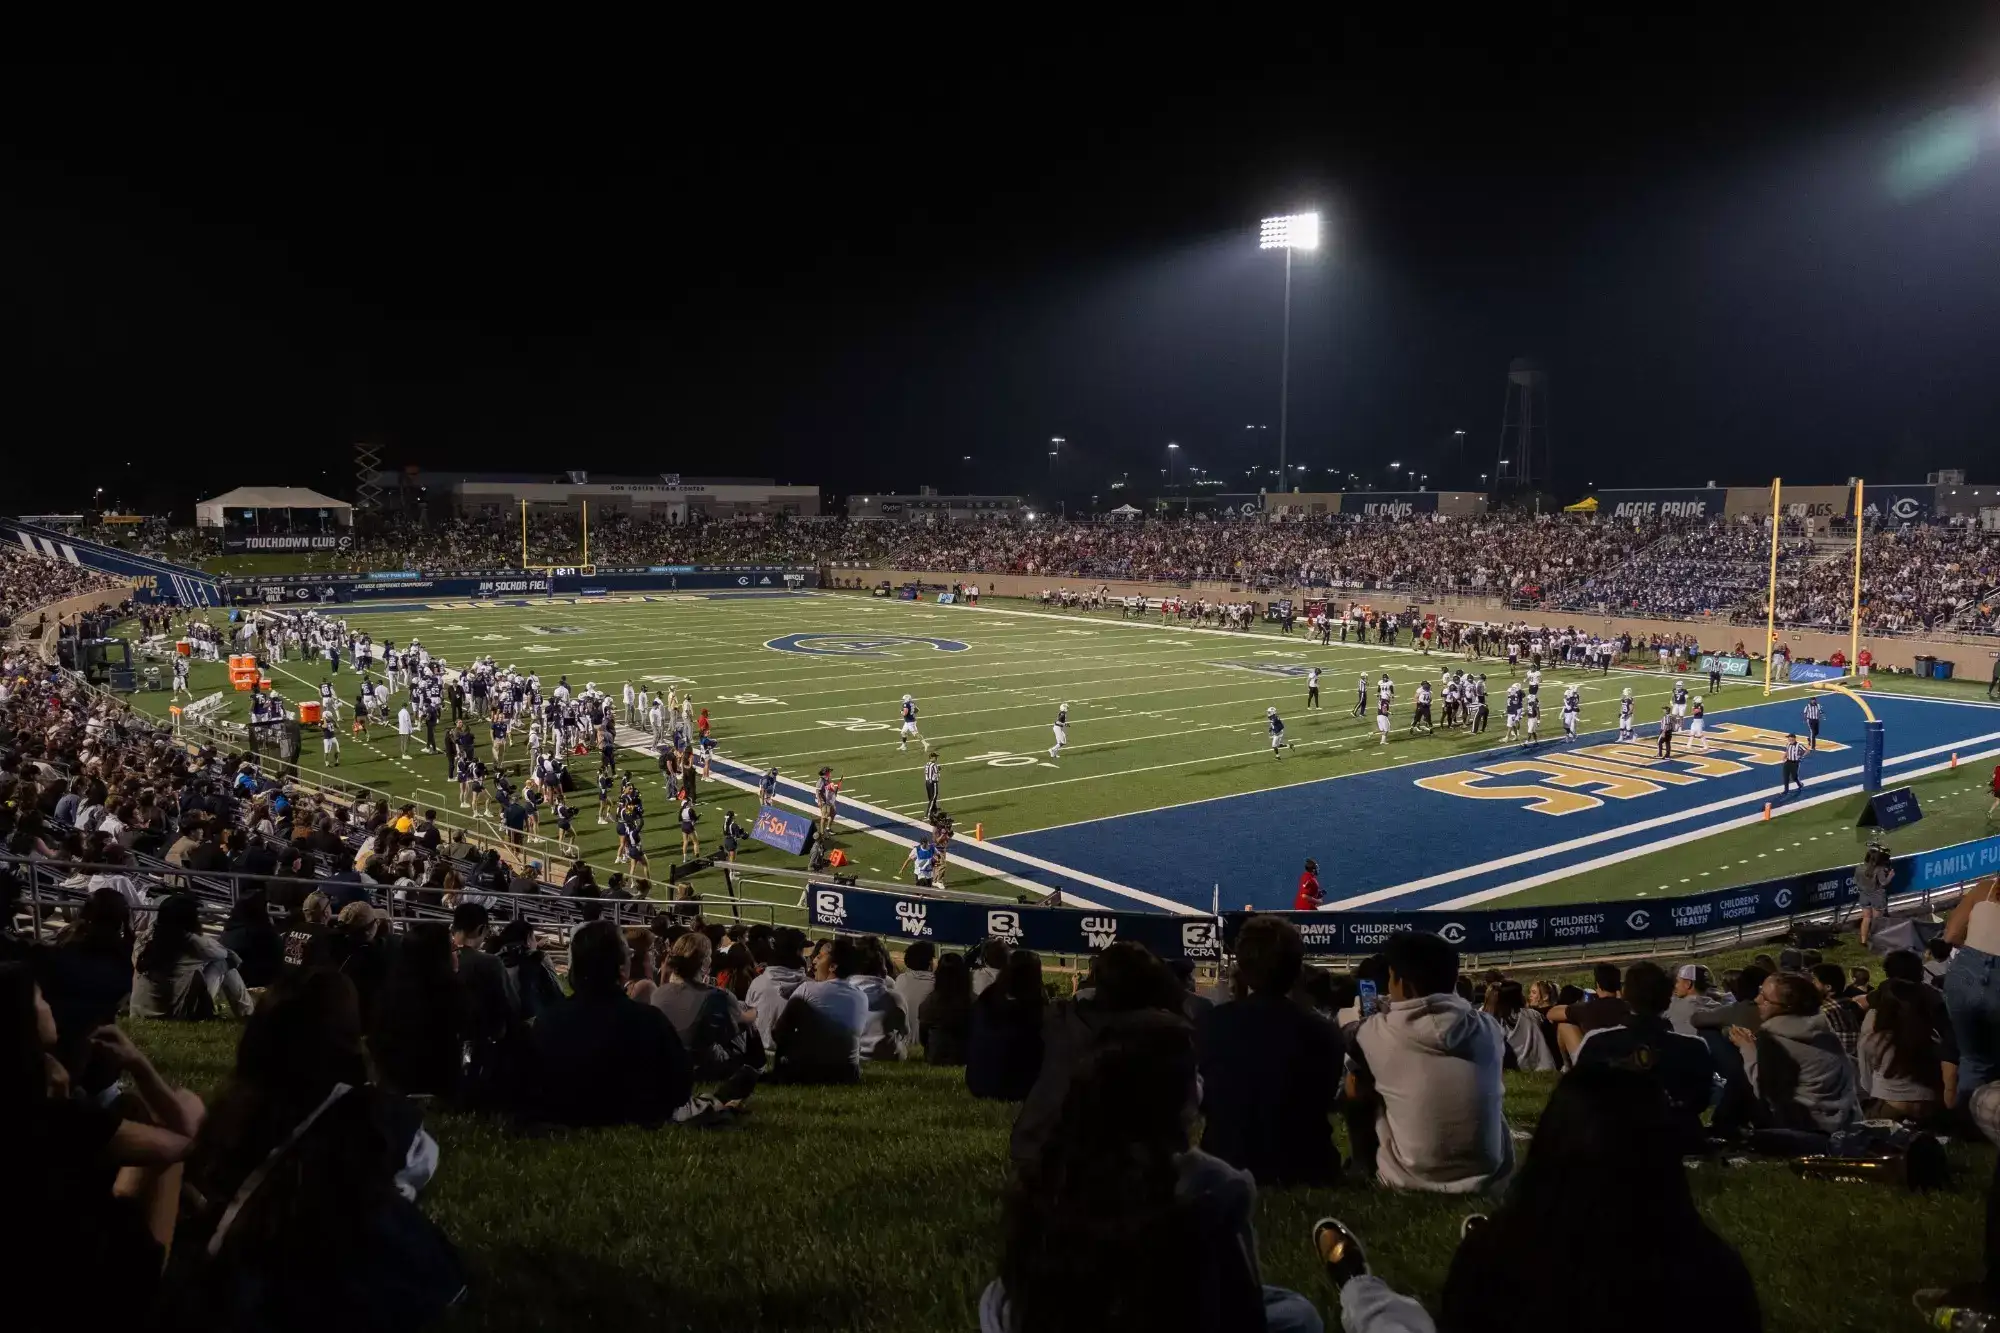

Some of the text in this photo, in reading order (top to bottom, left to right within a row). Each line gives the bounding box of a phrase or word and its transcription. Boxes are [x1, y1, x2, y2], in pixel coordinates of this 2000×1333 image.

[1364, 503, 1412, 515] UC DAVIS
[1614, 502, 1706, 517] AGGIE PRIDE
[246, 537, 309, 548] TOUCHDOWN
[312, 537, 335, 547] CLUB
[495, 581, 527, 591] SOCHOR
[815, 717, 891, 731] 20
[964, 751, 1039, 767] 10
[768, 817, 788, 836] Sol
[1925, 845, 2000, 880] FAMILY FU
[1720, 895, 1760, 910] CHILDREN'S
[896, 901, 927, 918] CW
[1723, 906, 1755, 919] HOSPITAL
[817, 914, 843, 925] KCRA
[1081, 917, 1117, 933] CW
[1490, 919, 1538, 932] UCDAVIS
[1550, 914, 1605, 927] CHILDREN'S
[1675, 914, 1708, 927] HEALTH
[290, 931, 312, 940] SALTY
[922, 926, 932, 935] 58
[1495, 930, 1533, 942] HEALTH
[1554, 927, 1600, 937] HOSPITAL
[1184, 948, 1216, 957] KCRA
